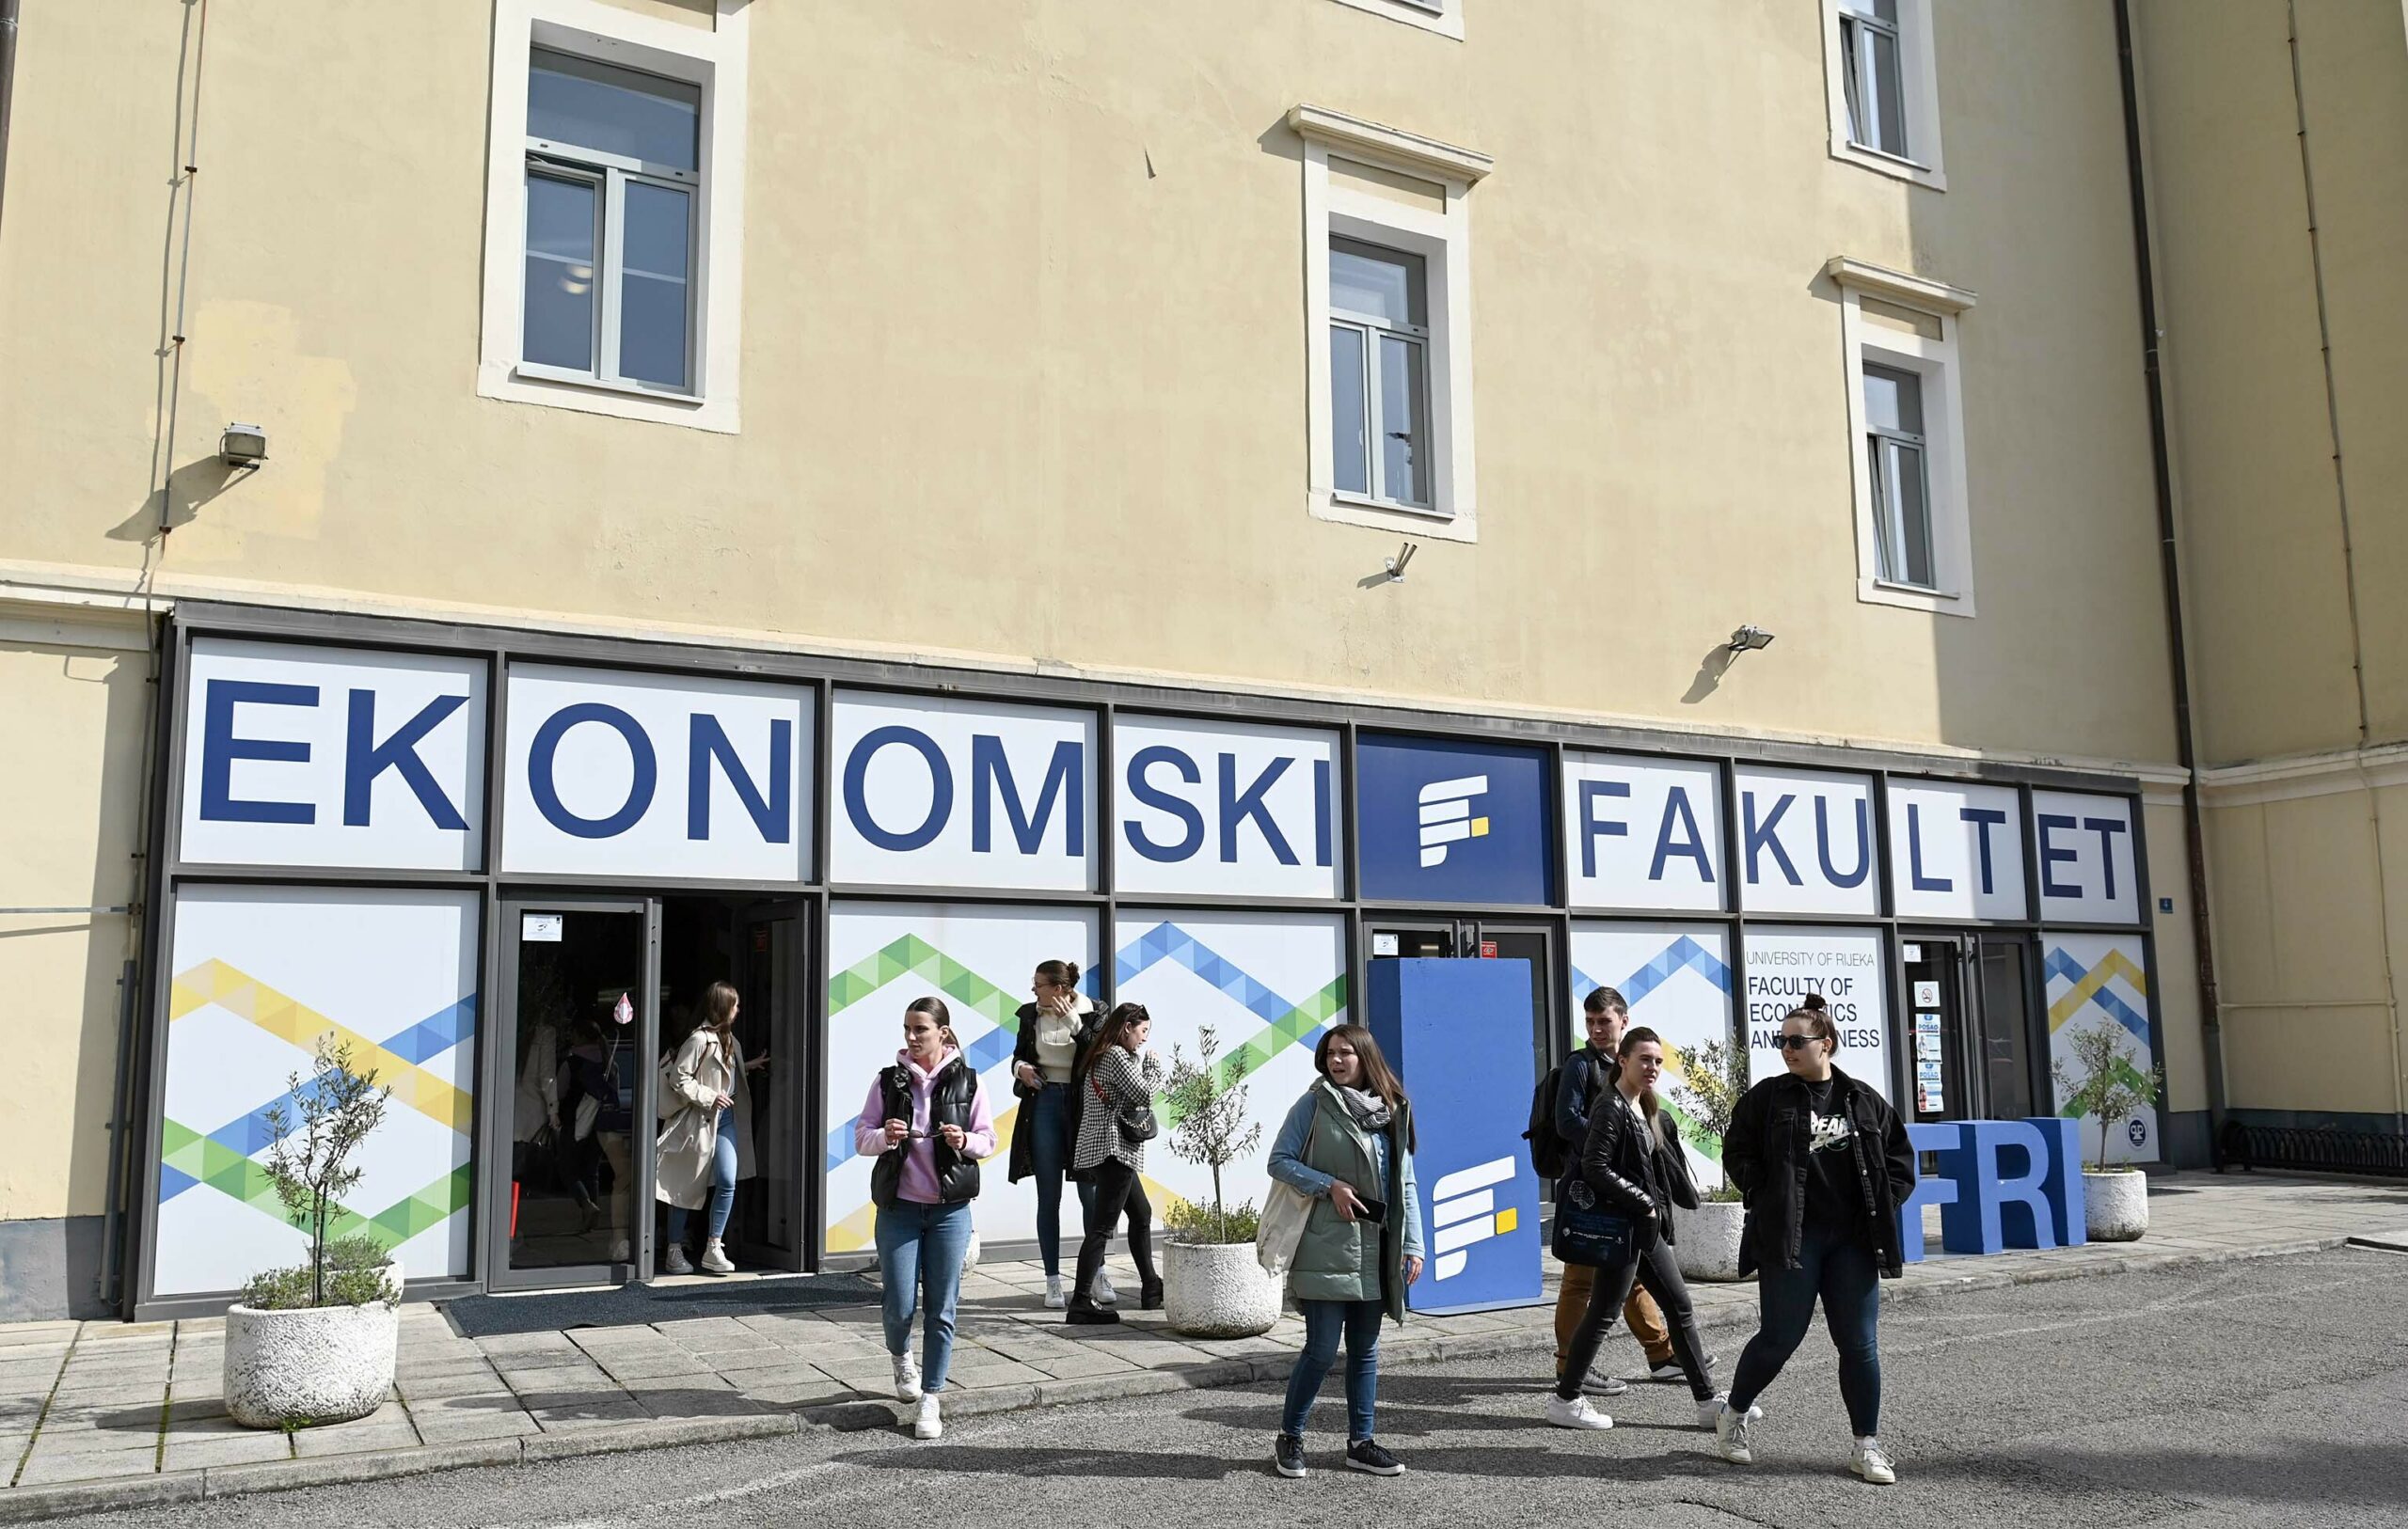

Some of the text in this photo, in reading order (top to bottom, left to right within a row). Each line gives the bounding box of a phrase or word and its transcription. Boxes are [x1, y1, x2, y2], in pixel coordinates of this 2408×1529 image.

[199, 678, 1333, 867] EKONOMSKI
[1577, 779, 2127, 900] FAKULTET
[1746, 951, 1875, 967] UNIVERSITY OF RIJEKA
[1748, 976, 1853, 996] FACULTY OF
[1750, 1003, 1858, 1022] ECOICS
[1751, 1030, 1782, 1049] AN
